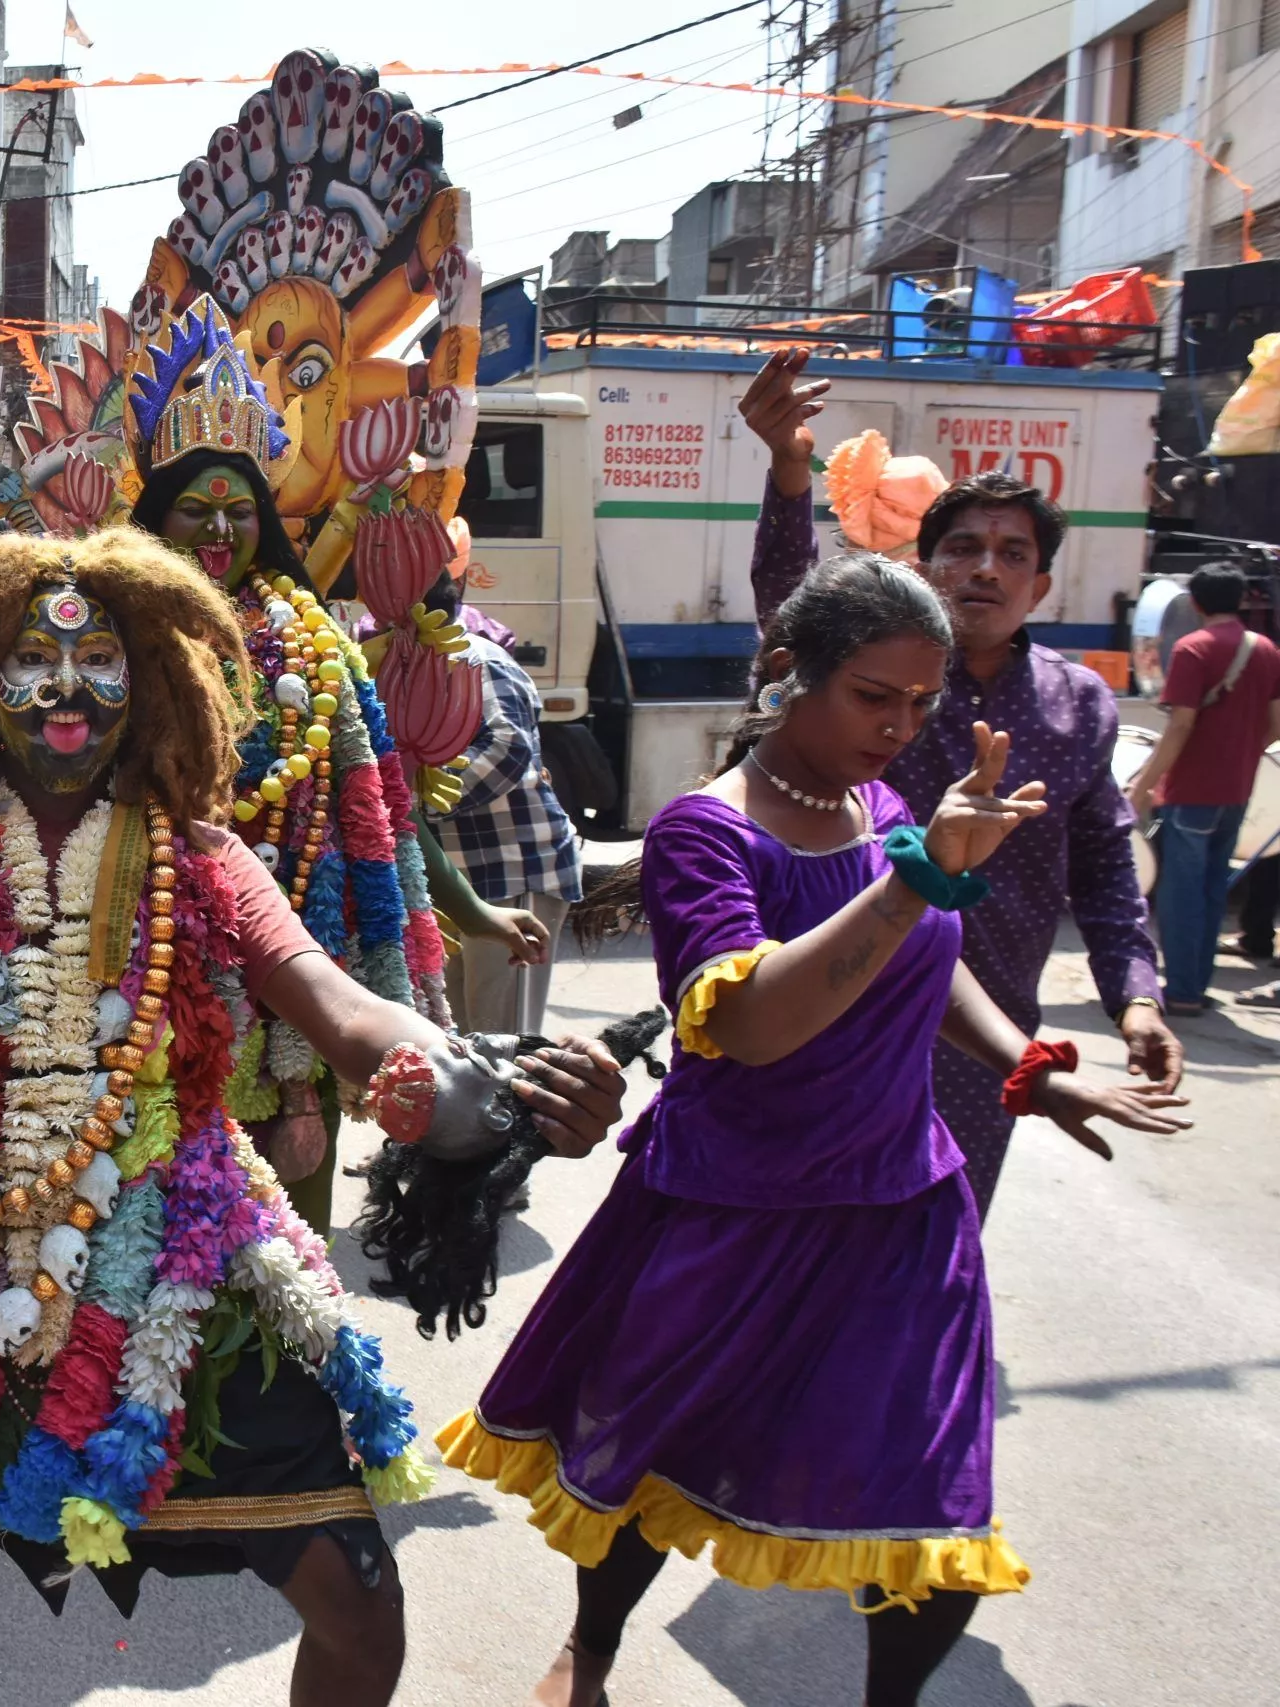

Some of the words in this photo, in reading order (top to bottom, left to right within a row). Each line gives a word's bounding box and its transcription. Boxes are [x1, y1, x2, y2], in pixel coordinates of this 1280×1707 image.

[599, 386, 630, 403] Cell:
[605, 424, 704, 442] 8179718282
[937, 417, 1013, 447] POWER
[1019, 420, 1070, 448] UNIT
[604, 447, 703, 466] 8639692307
[603, 469, 701, 490] 7893412313
